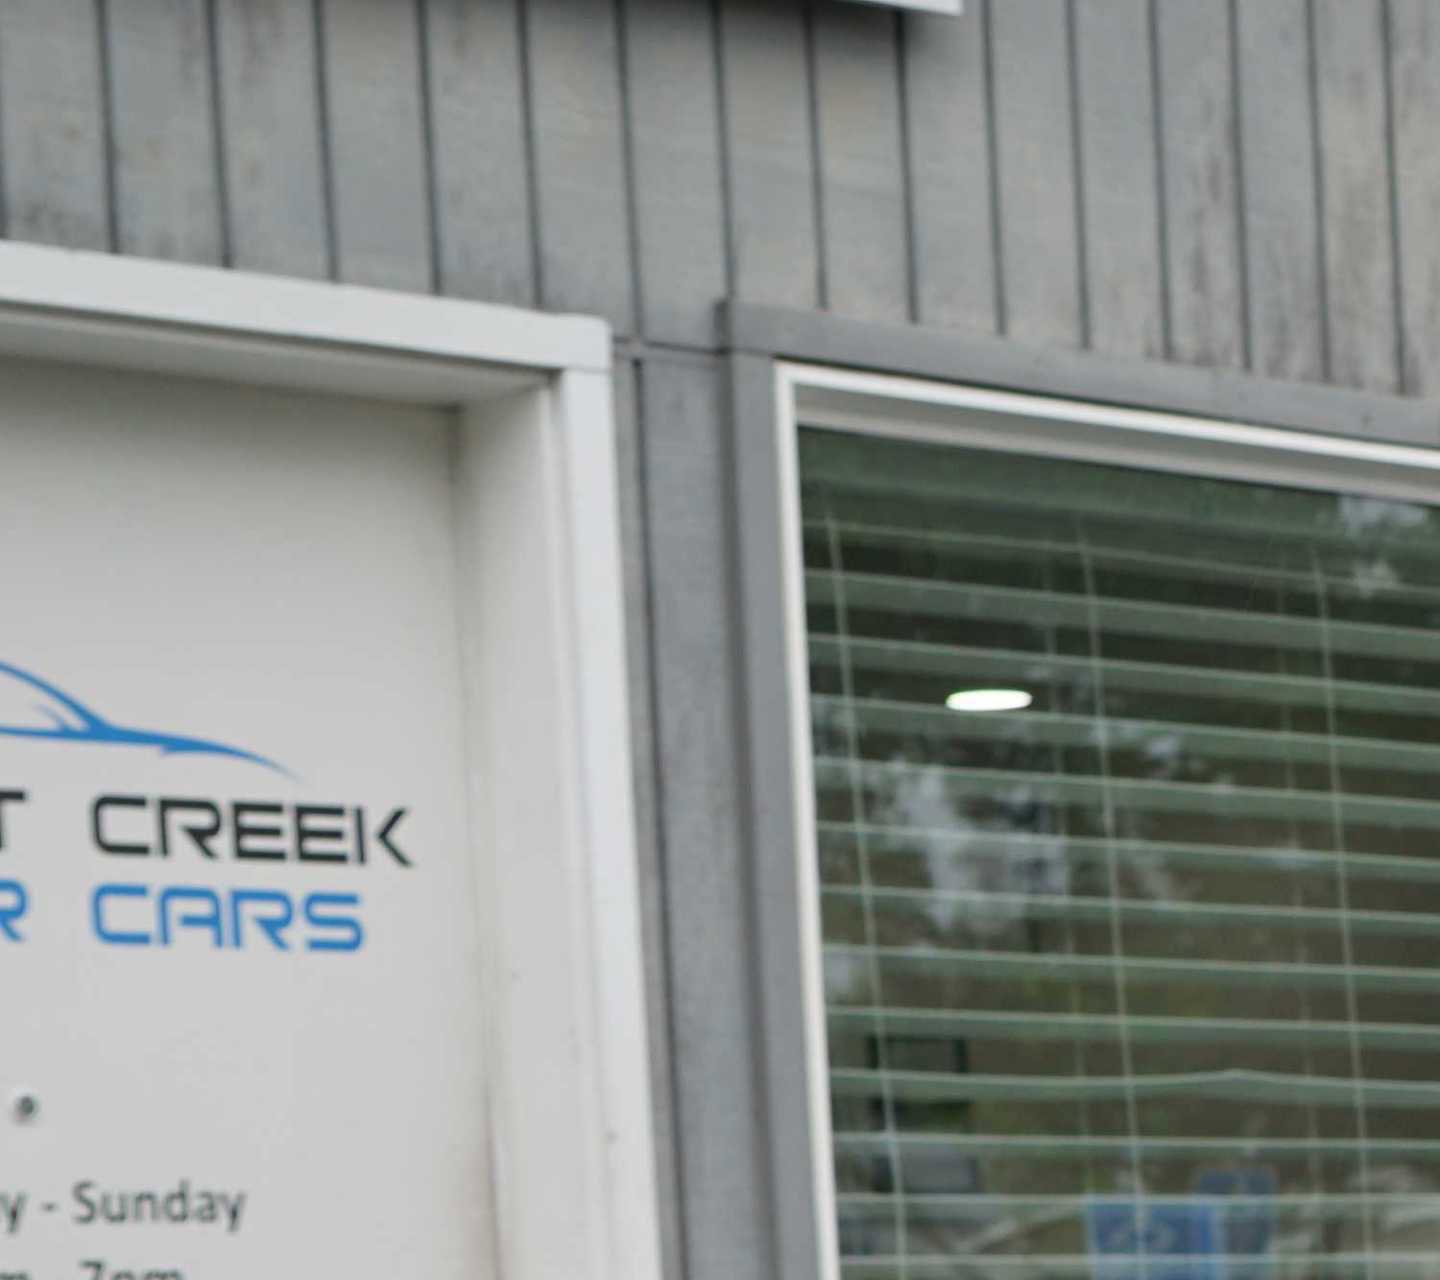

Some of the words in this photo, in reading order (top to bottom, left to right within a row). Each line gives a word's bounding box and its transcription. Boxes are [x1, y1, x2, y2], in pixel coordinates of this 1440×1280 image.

[92, 794, 412, 867] CREEK
[92, 883, 365, 952] CARS
[72, 1178, 247, 1235] Sunday
